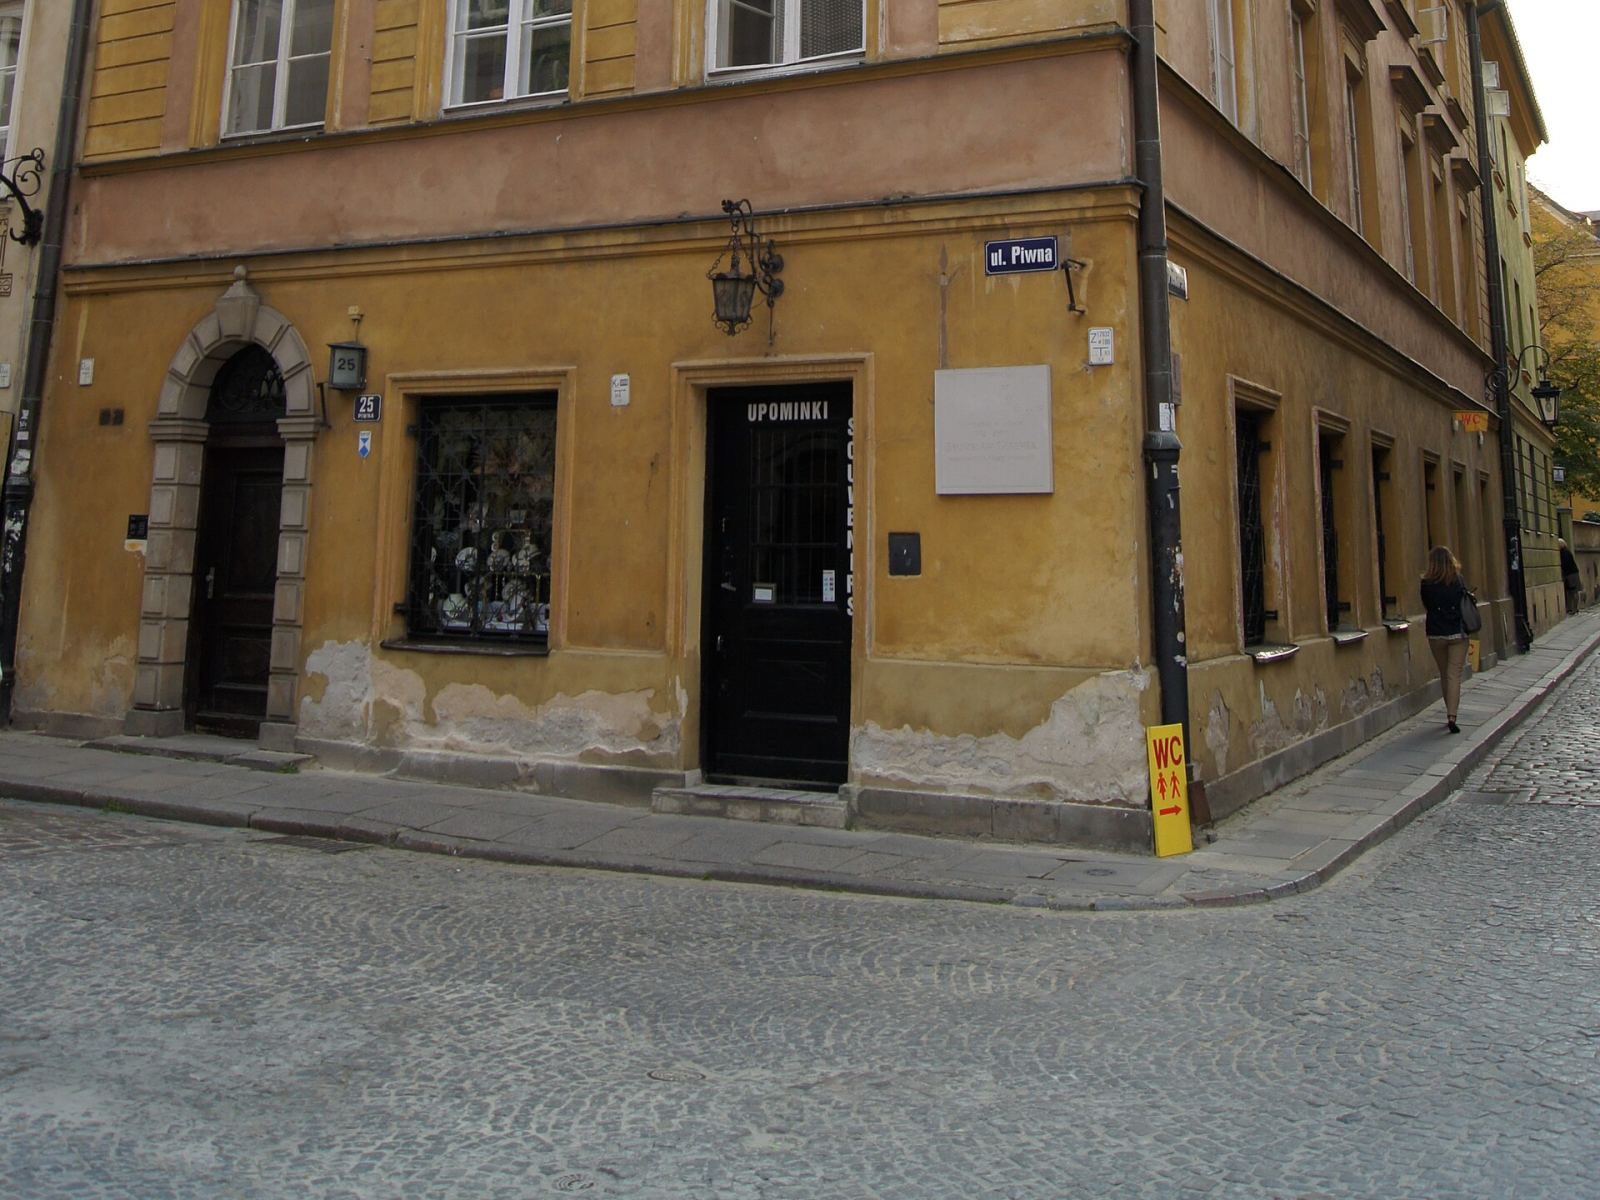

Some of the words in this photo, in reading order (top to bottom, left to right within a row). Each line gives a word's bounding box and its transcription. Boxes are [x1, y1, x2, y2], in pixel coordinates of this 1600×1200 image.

[991, 249, 1006, 266] ul.
[1011, 246, 1052, 264] Piwna
[338, 359, 355, 371] 25
[360, 397, 374, 413] 25
[748, 401, 828, 421] UPOMINKI
[1462, 414, 1480, 425] WC
[1153, 736, 1182, 769] WC
